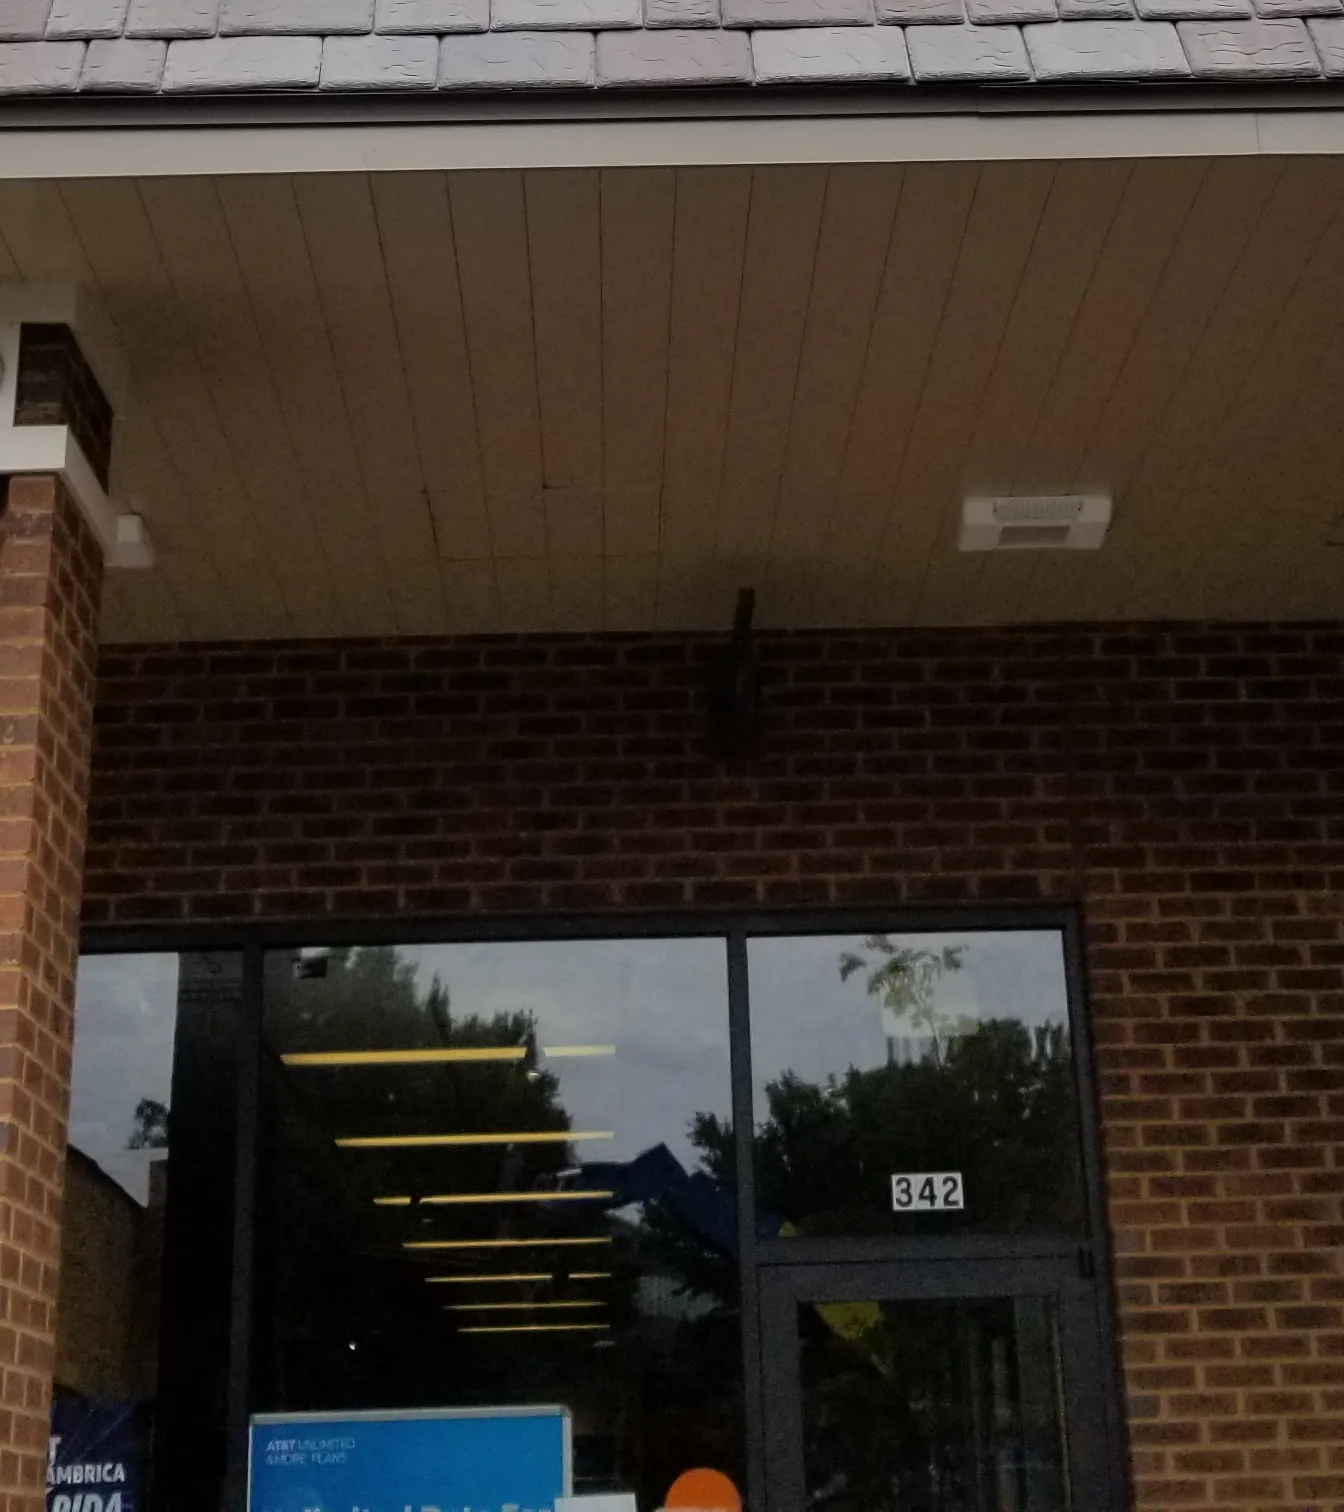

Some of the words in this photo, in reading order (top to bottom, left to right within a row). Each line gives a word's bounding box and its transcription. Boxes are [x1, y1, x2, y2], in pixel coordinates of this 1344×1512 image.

[895, 1175, 959, 1208] 342
[266, 1439, 295, 1452] AT&T
[311, 1452, 346, 1465] PLANS
